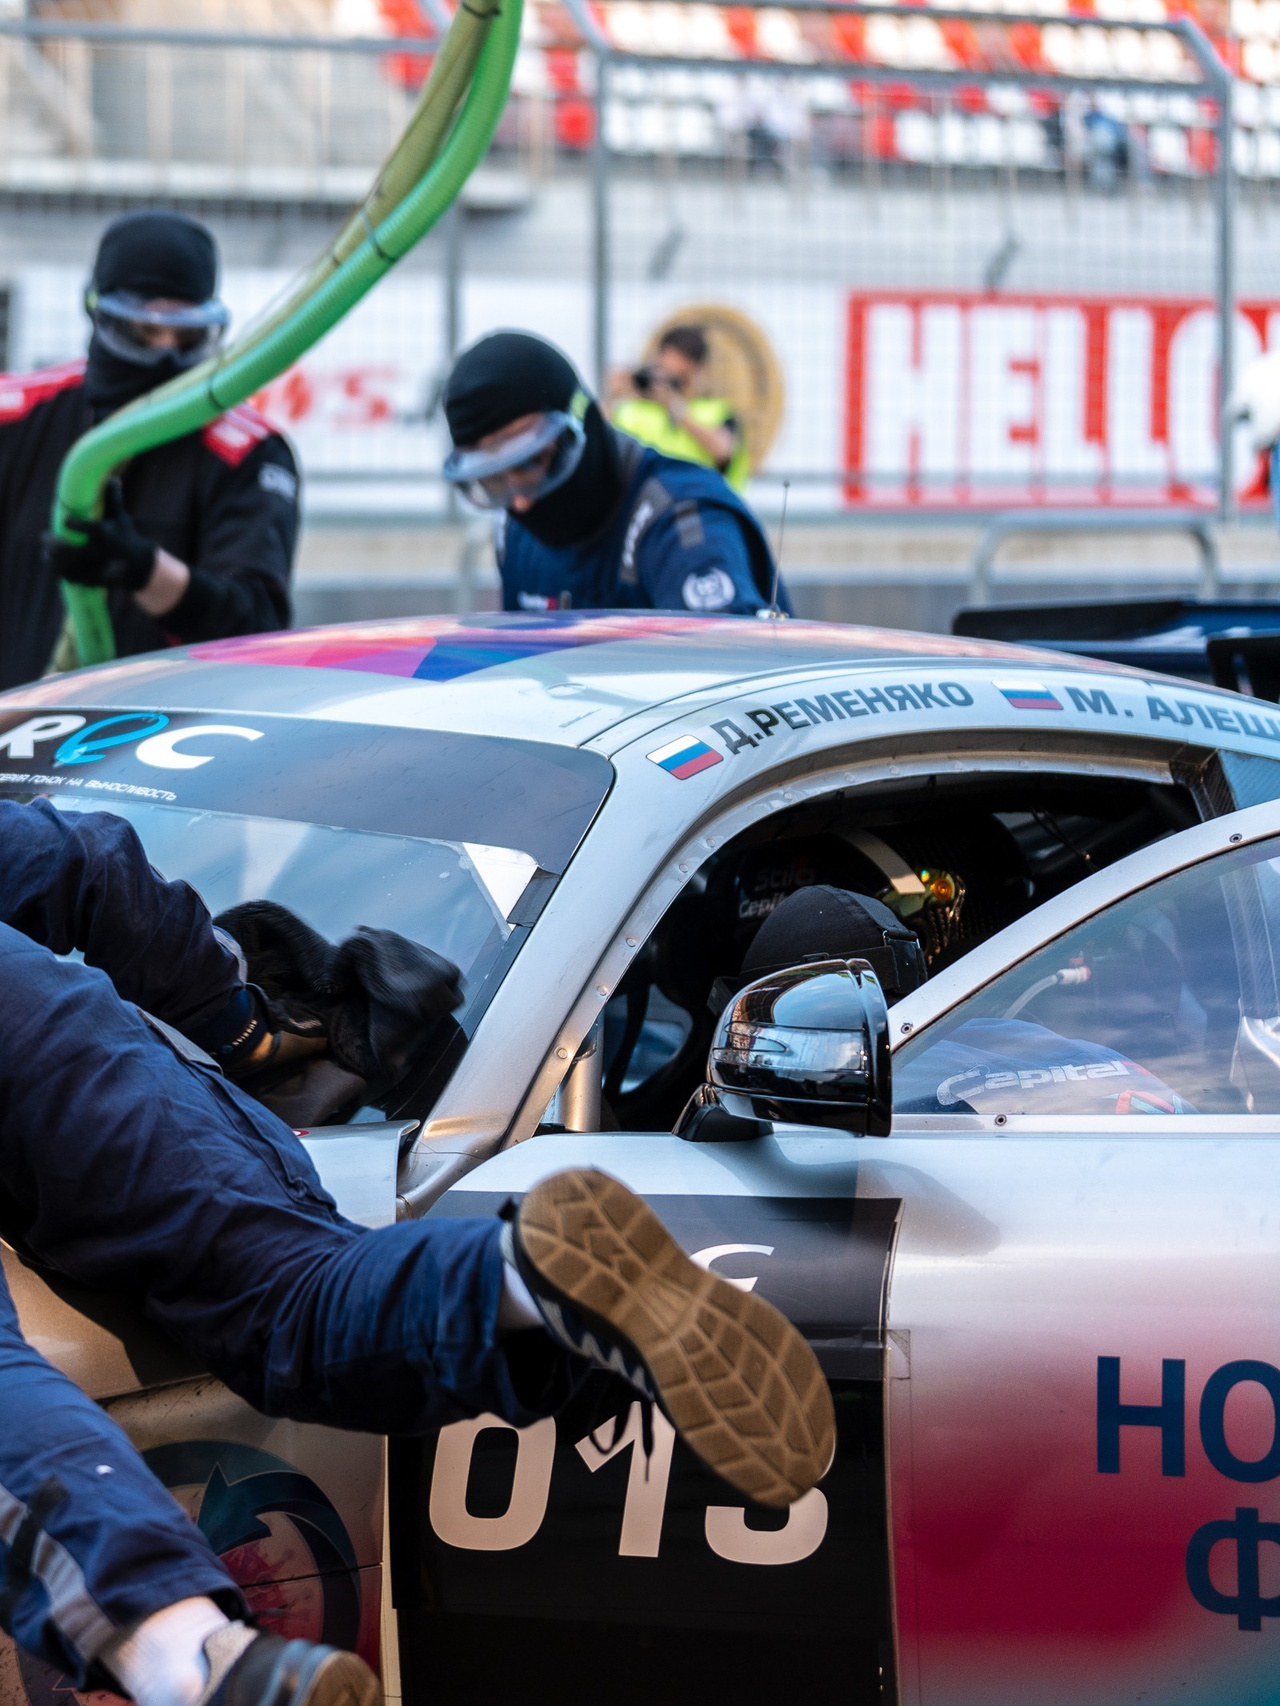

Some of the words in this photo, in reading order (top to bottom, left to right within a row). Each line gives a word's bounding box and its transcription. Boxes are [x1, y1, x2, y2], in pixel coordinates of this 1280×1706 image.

[863, 302, 1280, 506] HELLO
[65, 778, 84, 787] НА
[84, 779, 178, 801] ВЫНОСЛИВОСТЬ
